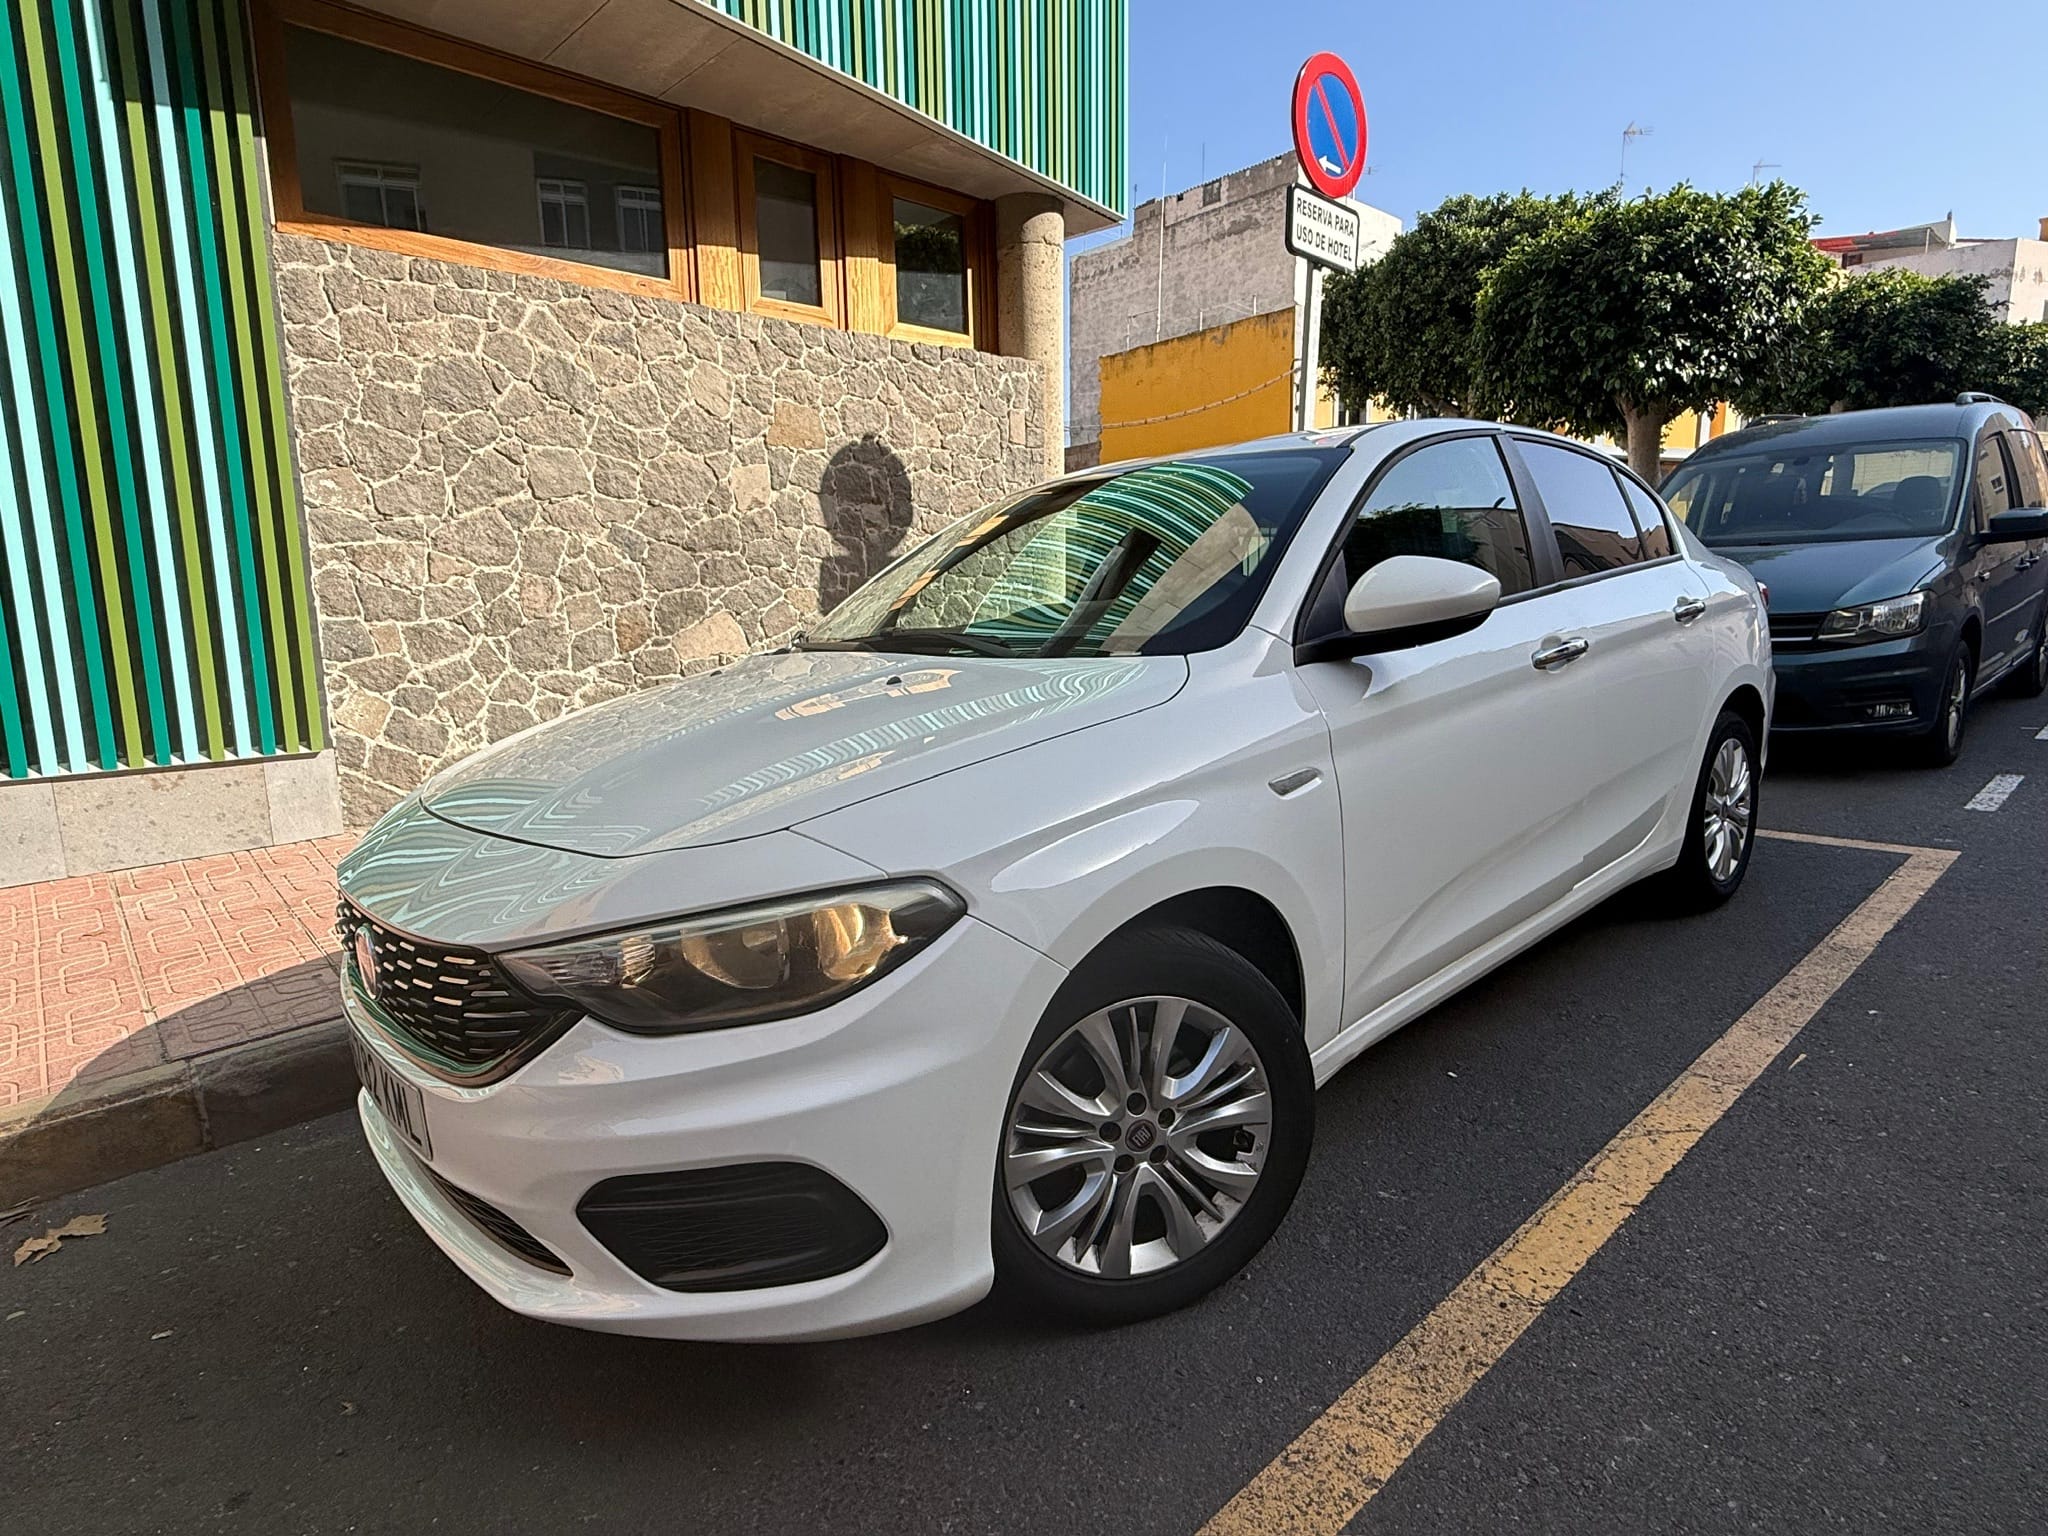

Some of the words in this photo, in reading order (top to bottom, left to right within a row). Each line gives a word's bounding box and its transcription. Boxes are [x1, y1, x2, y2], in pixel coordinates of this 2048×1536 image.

[1296, 197, 1332, 228] RESERVA
[1334, 214, 1354, 239] PARA
[1296, 223, 1313, 245] USO
[1315, 231, 1326, 251] DE
[1327, 236, 1352, 262] HOTEL
[1132, 1126, 1151, 1146] FIAT
